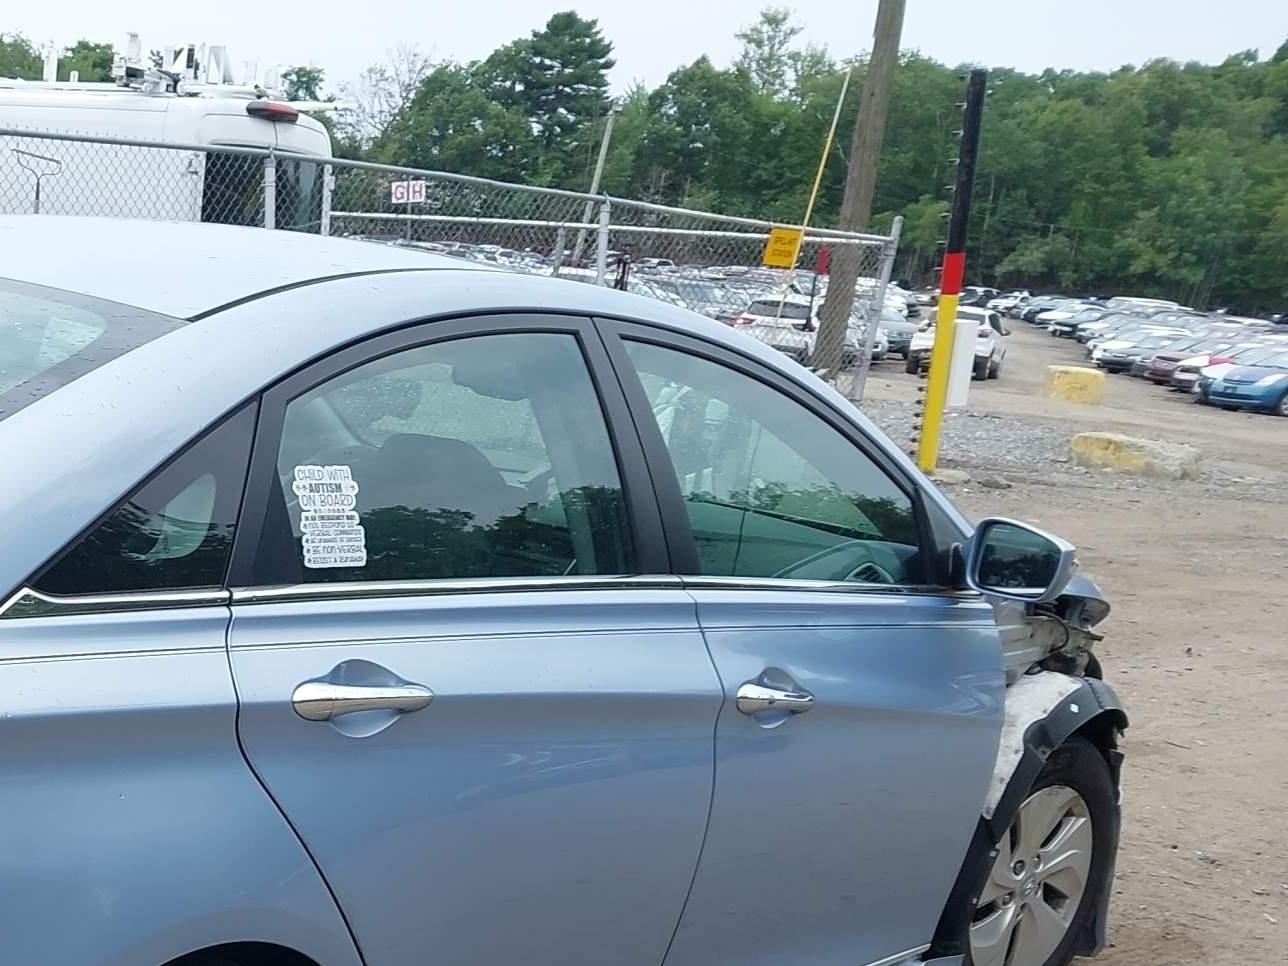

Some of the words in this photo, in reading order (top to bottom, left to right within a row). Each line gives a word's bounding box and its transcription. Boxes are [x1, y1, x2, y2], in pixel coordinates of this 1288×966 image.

[296, 469, 323, 481] CHILD
[324, 469, 350, 480] WITH
[309, 483, 343, 493] AUTISM
[301, 495, 316, 507] ON
[319, 494, 353, 507] BOARD
